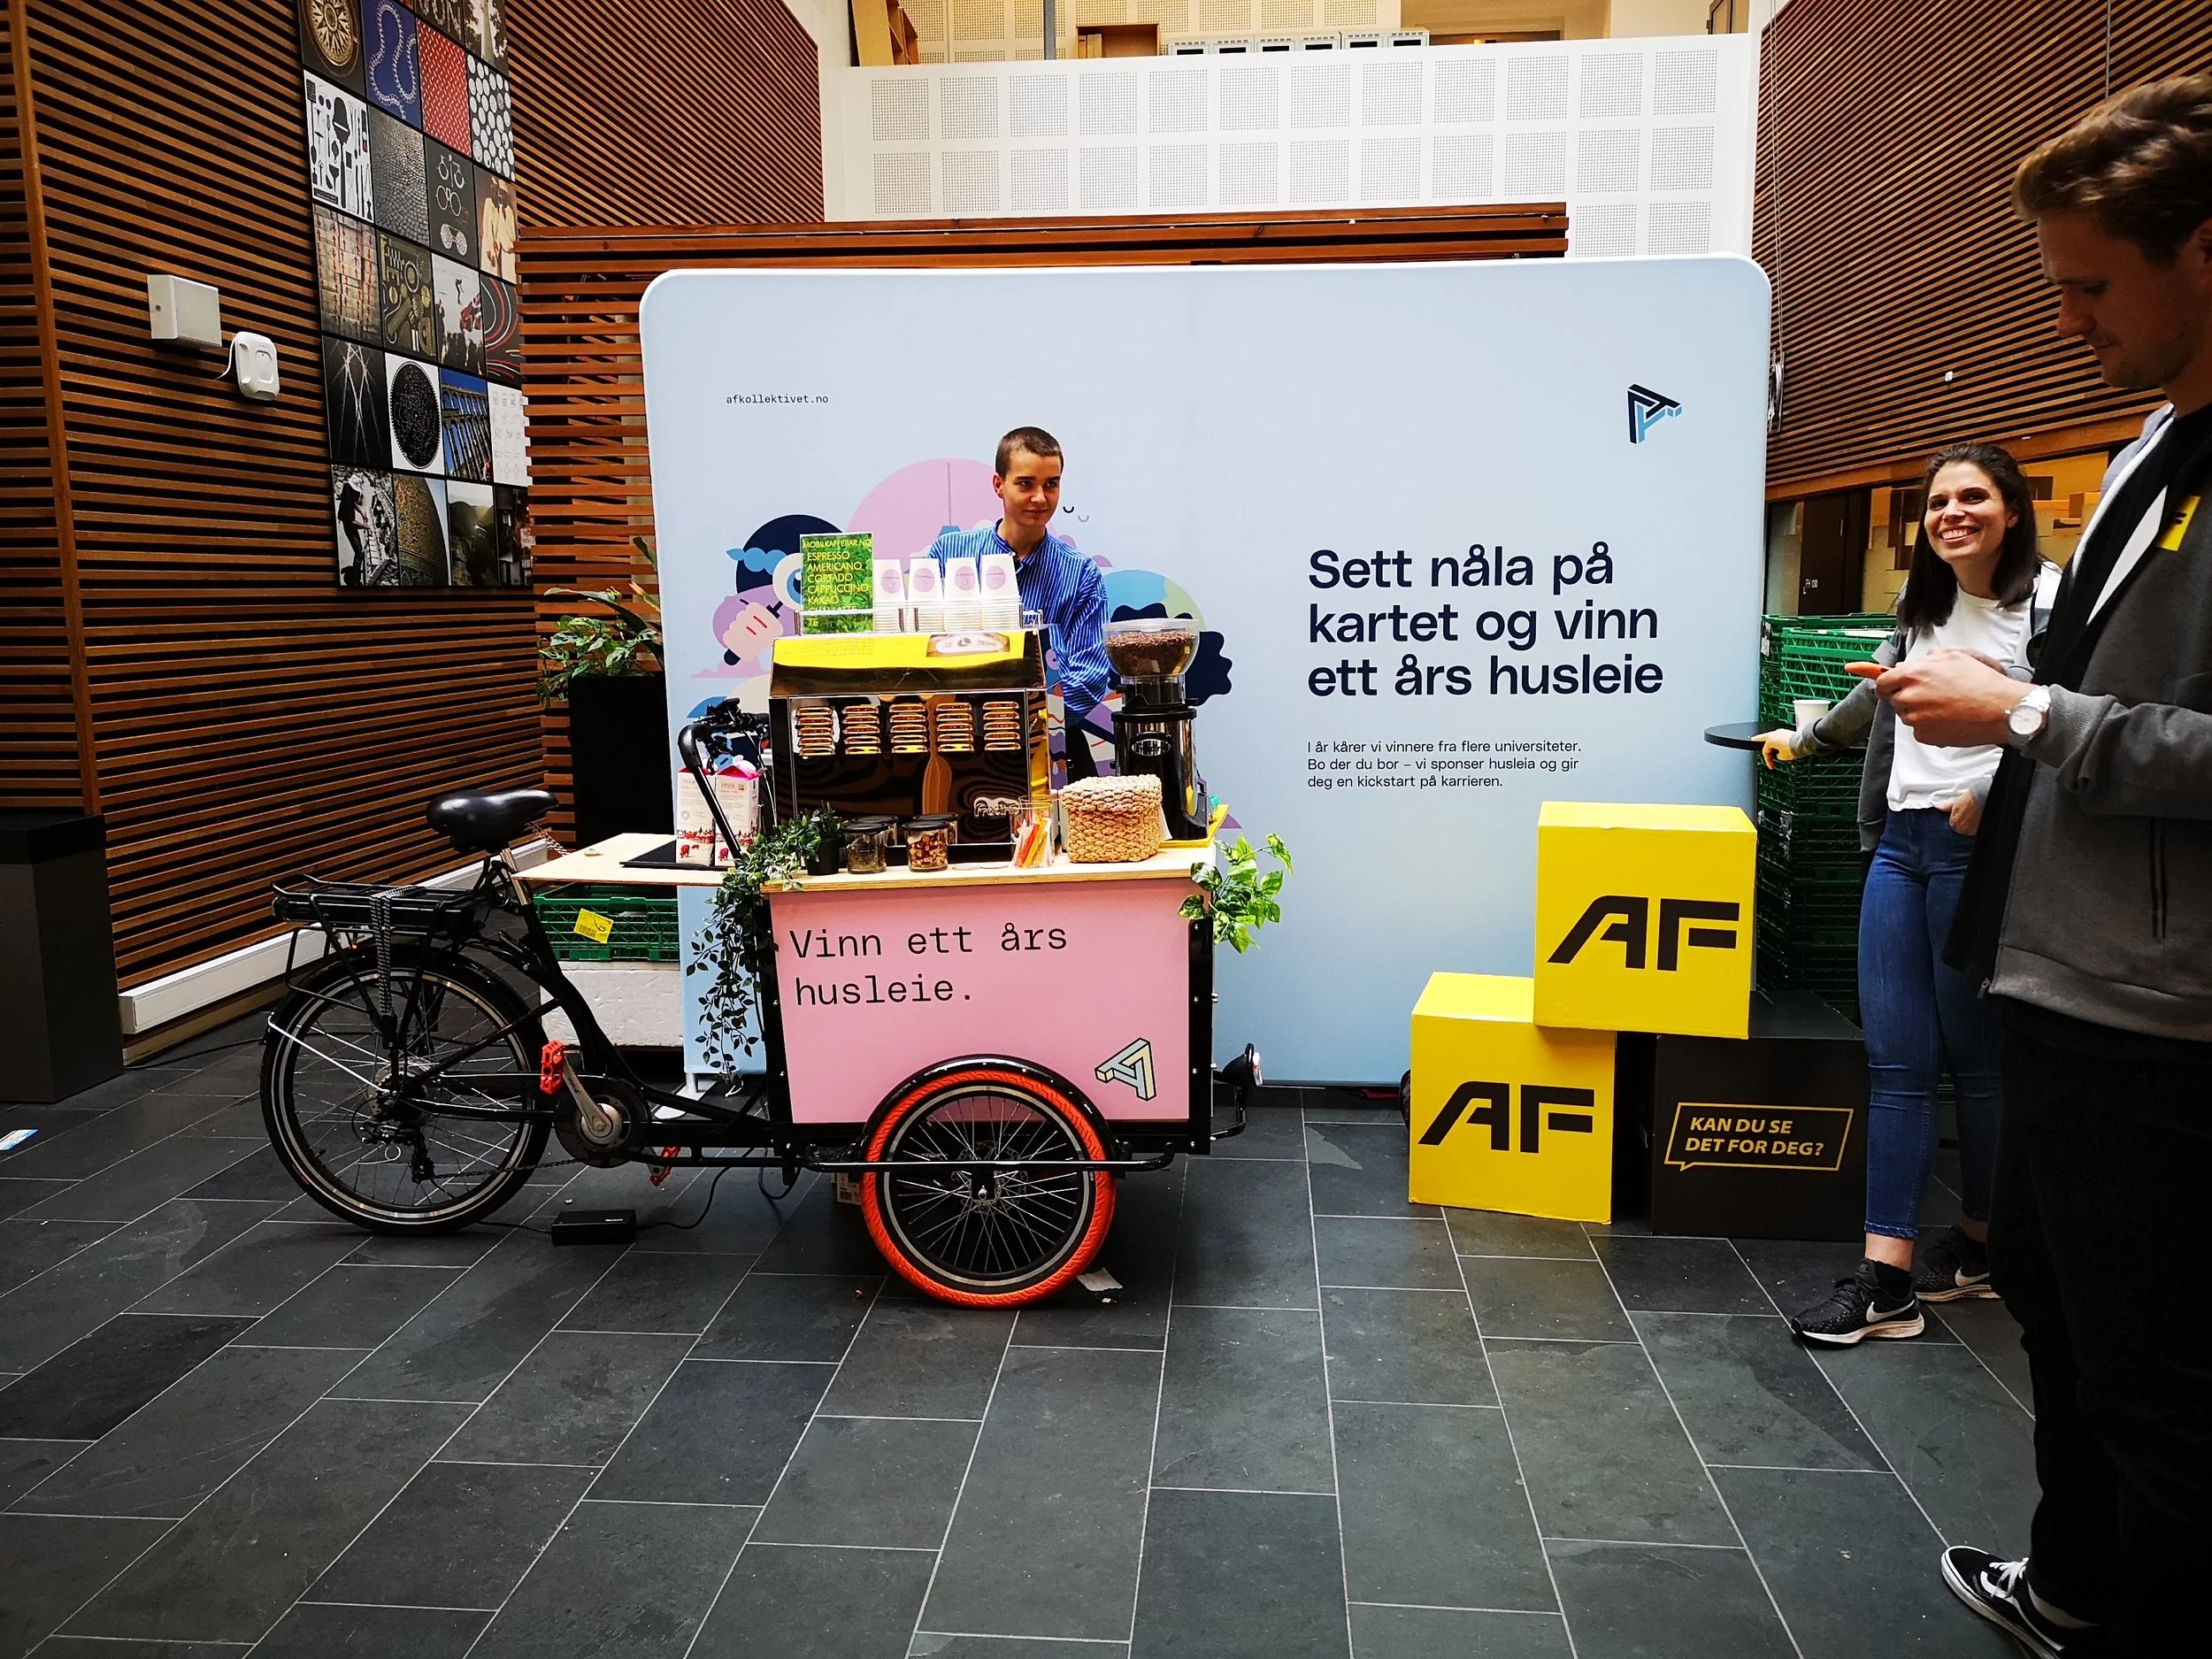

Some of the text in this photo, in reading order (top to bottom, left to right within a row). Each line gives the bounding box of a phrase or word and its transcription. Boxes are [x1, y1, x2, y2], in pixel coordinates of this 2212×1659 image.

[726, 394, 829, 404] afkollektivet.no
[807, 550, 850, 561] ESPRESSO
[807, 561, 863, 572] AMERICANO
[1309, 541, 1613, 595] Sett nåla på
[807, 572, 854, 583] CORTADO
[807, 583, 869, 594] CAPPUCCINO
[808, 595, 840, 605] KAKAO
[1310, 599, 1658, 650] kartet og vinn
[1308, 653, 1663, 697] ett års husleie
[1315, 740, 1329, 752] år
[1333, 740, 1367, 752] kårer
[1371, 740, 1381, 752] vi
[1386, 741, 1434, 752] vinnere
[1438, 740, 1457, 752] fra
[1461, 740, 1491, 752] flere
[1495, 740, 1582, 752] universiteter.
[1308, 758, 1326, 770] Bo
[1330, 757, 1352, 770] der
[1356, 757, 1372, 770] du
[1377, 757, 1400, 770] bor
[1415, 757, 1426, 770] vi
[1430, 760, 1485, 772] sponser
[1488, 757, 1536, 770] husleia
[1540, 761, 1557, 772] og
[1561, 757, 1579, 772] gir
[1308, 774, 1503, 790] deg en kickstart på karrieren.
[788, 922, 1067, 958] Vinn ett års
[1546, 895, 1740, 972] AF
[795, 973, 972, 1006] husleie.
[1417, 1080, 1594, 1154] AF
[1690, 1117, 1793, 1134] KAN DU SE
[1685, 1137, 1824, 1156] DET FOR DEG?
